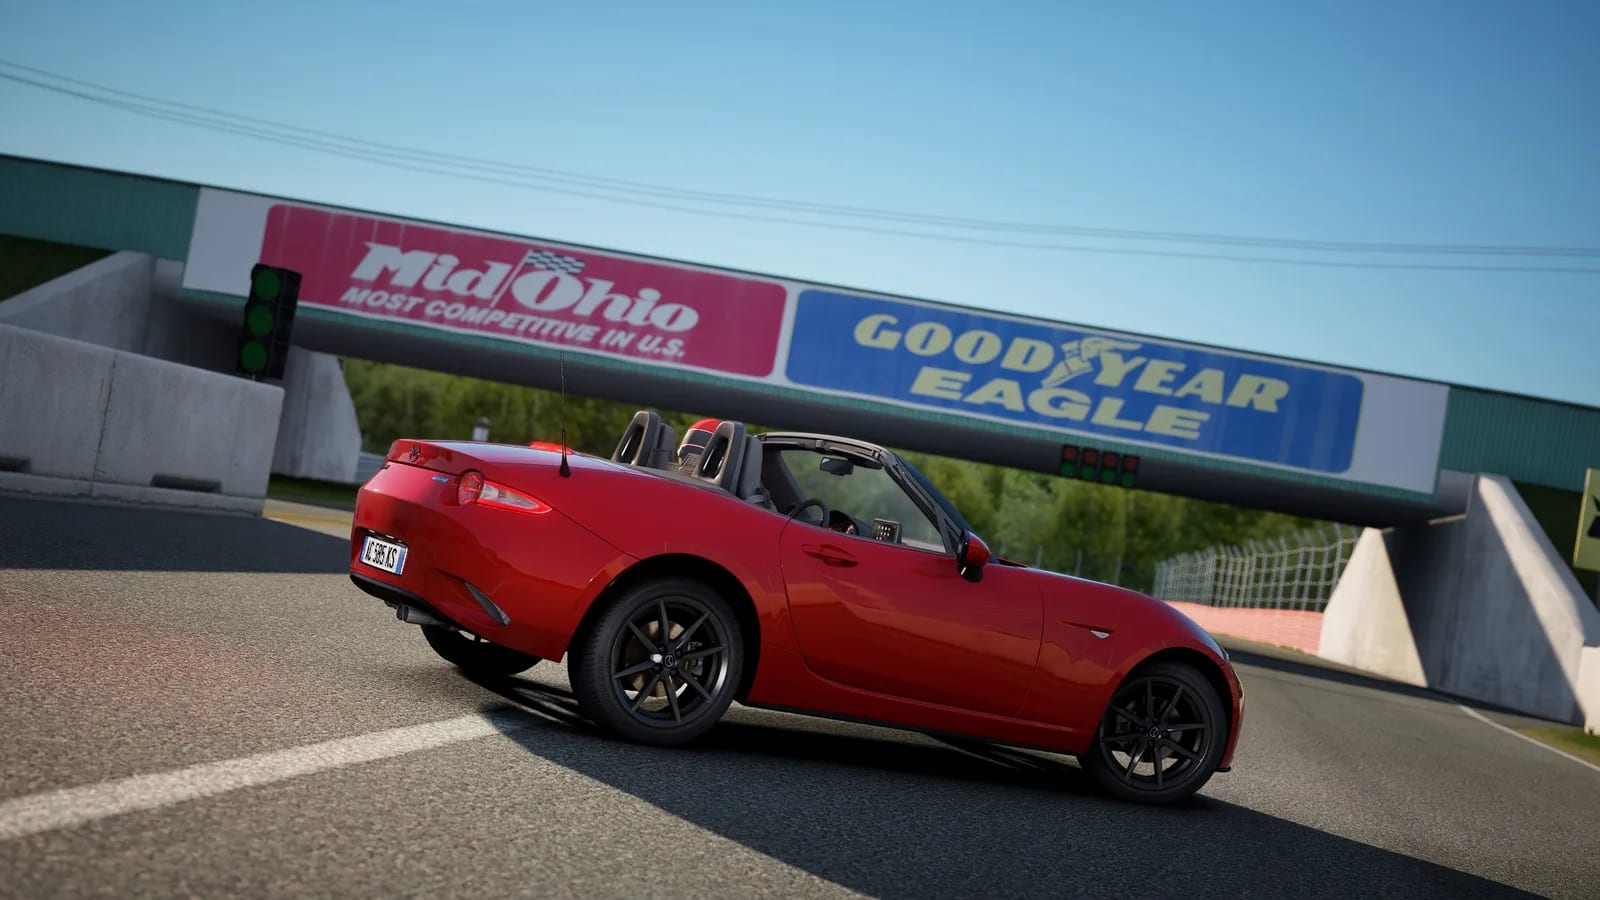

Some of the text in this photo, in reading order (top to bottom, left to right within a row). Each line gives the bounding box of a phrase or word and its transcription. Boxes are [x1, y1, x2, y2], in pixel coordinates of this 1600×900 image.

[340, 287, 686, 357] MOST COMPETITIVE IN U.S.
[351, 242, 699, 332] Mid Ohio
[911, 366, 1210, 439] EAGLE
